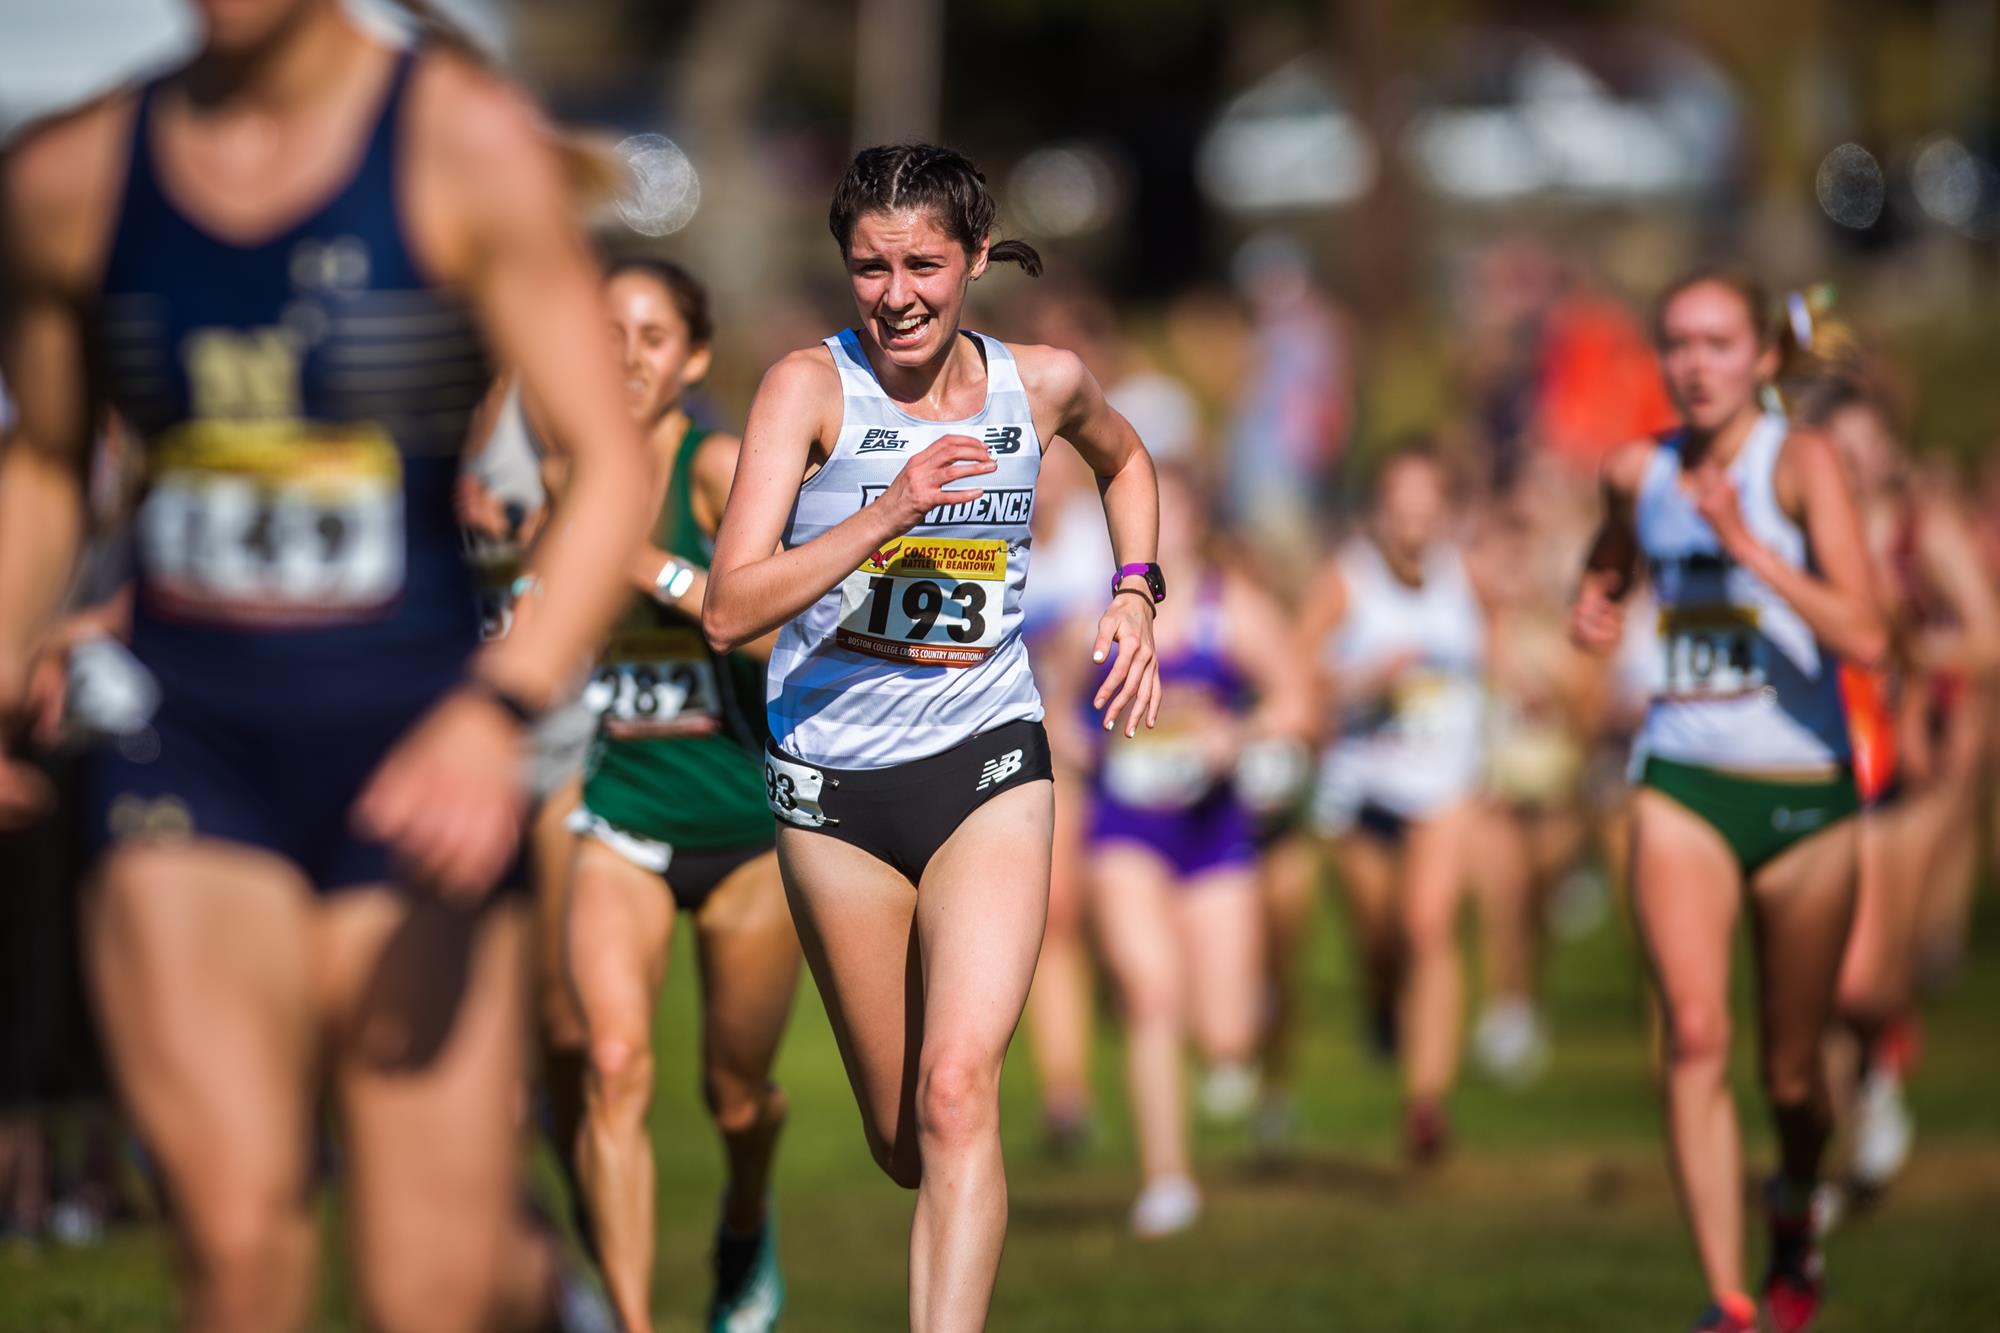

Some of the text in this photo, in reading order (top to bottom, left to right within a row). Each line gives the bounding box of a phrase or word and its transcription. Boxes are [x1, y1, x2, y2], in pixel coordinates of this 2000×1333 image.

[860, 439, 909, 449] EAST
[864, 428, 899, 439] BIG
[984, 426, 1022, 455] NB
[862, 486, 1033, 525] VIDENCE
[901, 559, 996, 571] BATTLE IN BEANTOWN
[903, 546, 997, 561] COAST-TO-COAST
[868, 576, 987, 643] 193
[847, 636, 985, 662] BOSTON COLLEGE CROSS COUNTRY INVITATIONAL
[976, 749, 1023, 791] NB
